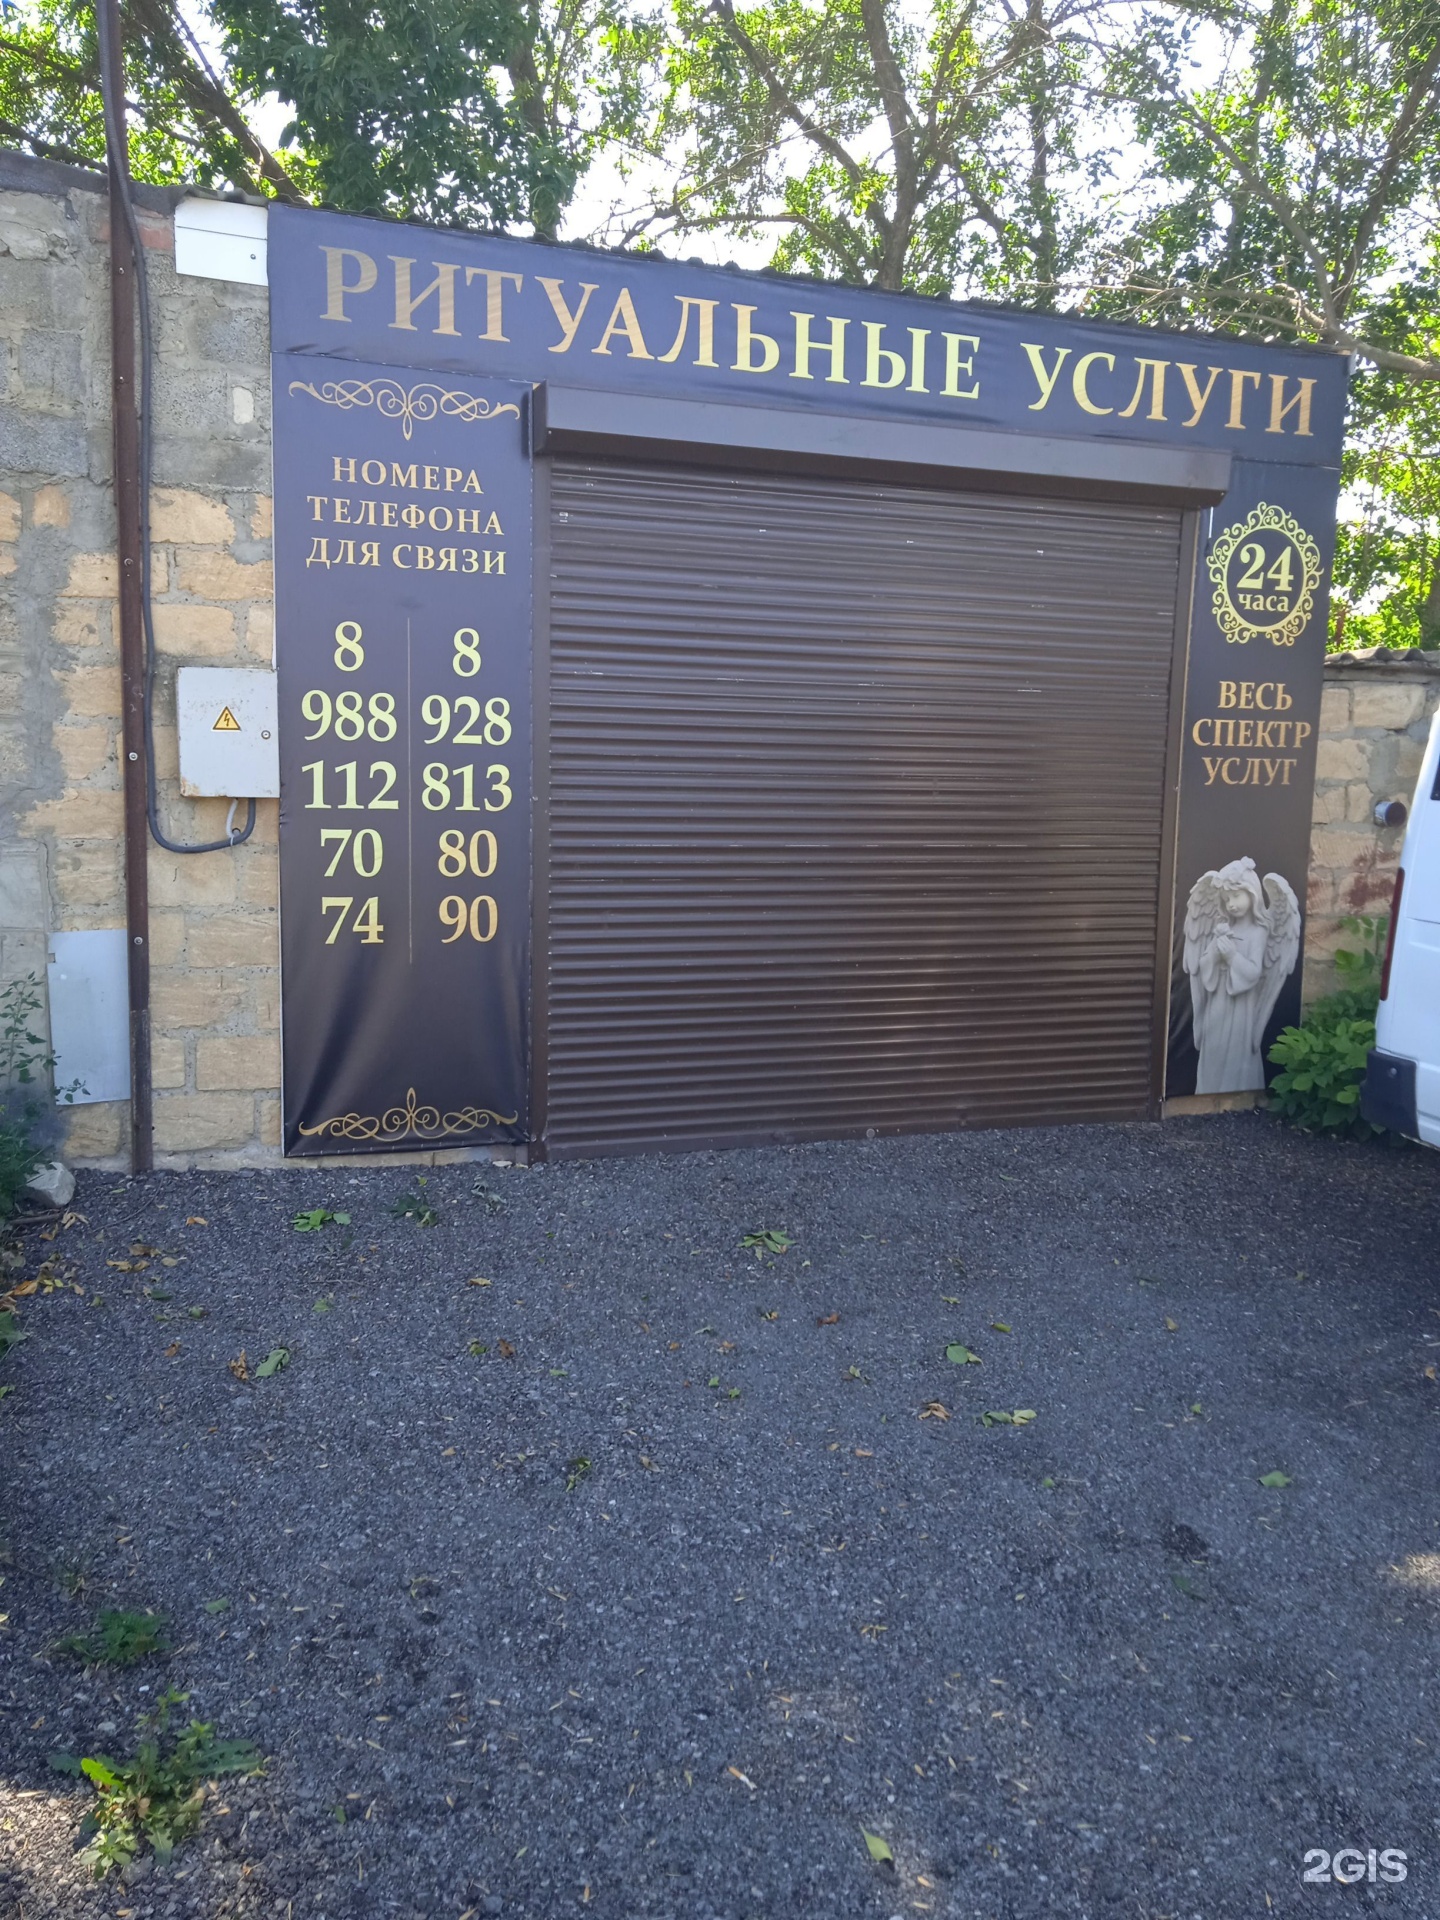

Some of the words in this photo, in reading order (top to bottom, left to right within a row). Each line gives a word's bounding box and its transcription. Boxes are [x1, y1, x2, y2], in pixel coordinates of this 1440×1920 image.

[318, 245, 981, 400] РИТУАЛЬНЫЕ
[1020, 342, 1317, 437] УСЛУГИ
[331, 456, 485, 495] НОМЕРА
[306, 494, 505, 536] ТЕЛЕФОНА
[305, 537, 381, 569] ДЛЯ
[391, 543, 507, 576] СВЯЗИ
[1238, 542, 1295, 593] 24
[1238, 592, 1290, 614] часа
[333, 620, 365, 673] 8
[452, 627, 482, 678] 8
[300, 688, 398, 742] 988
[420, 694, 513, 746] 928
[1218, 680, 1293, 712] ВЕСЬ
[1191, 718, 1311, 750] СПЕКТР
[300, 760, 399, 811] 112
[420, 761, 513, 812] 813
[1203, 756, 1298, 786] УСЛУГ
[319, 828, 384, 878] 70
[437, 829, 499, 878] 80
[320, 895, 384, 945] 74
[437, 895, 499, 944] 90
